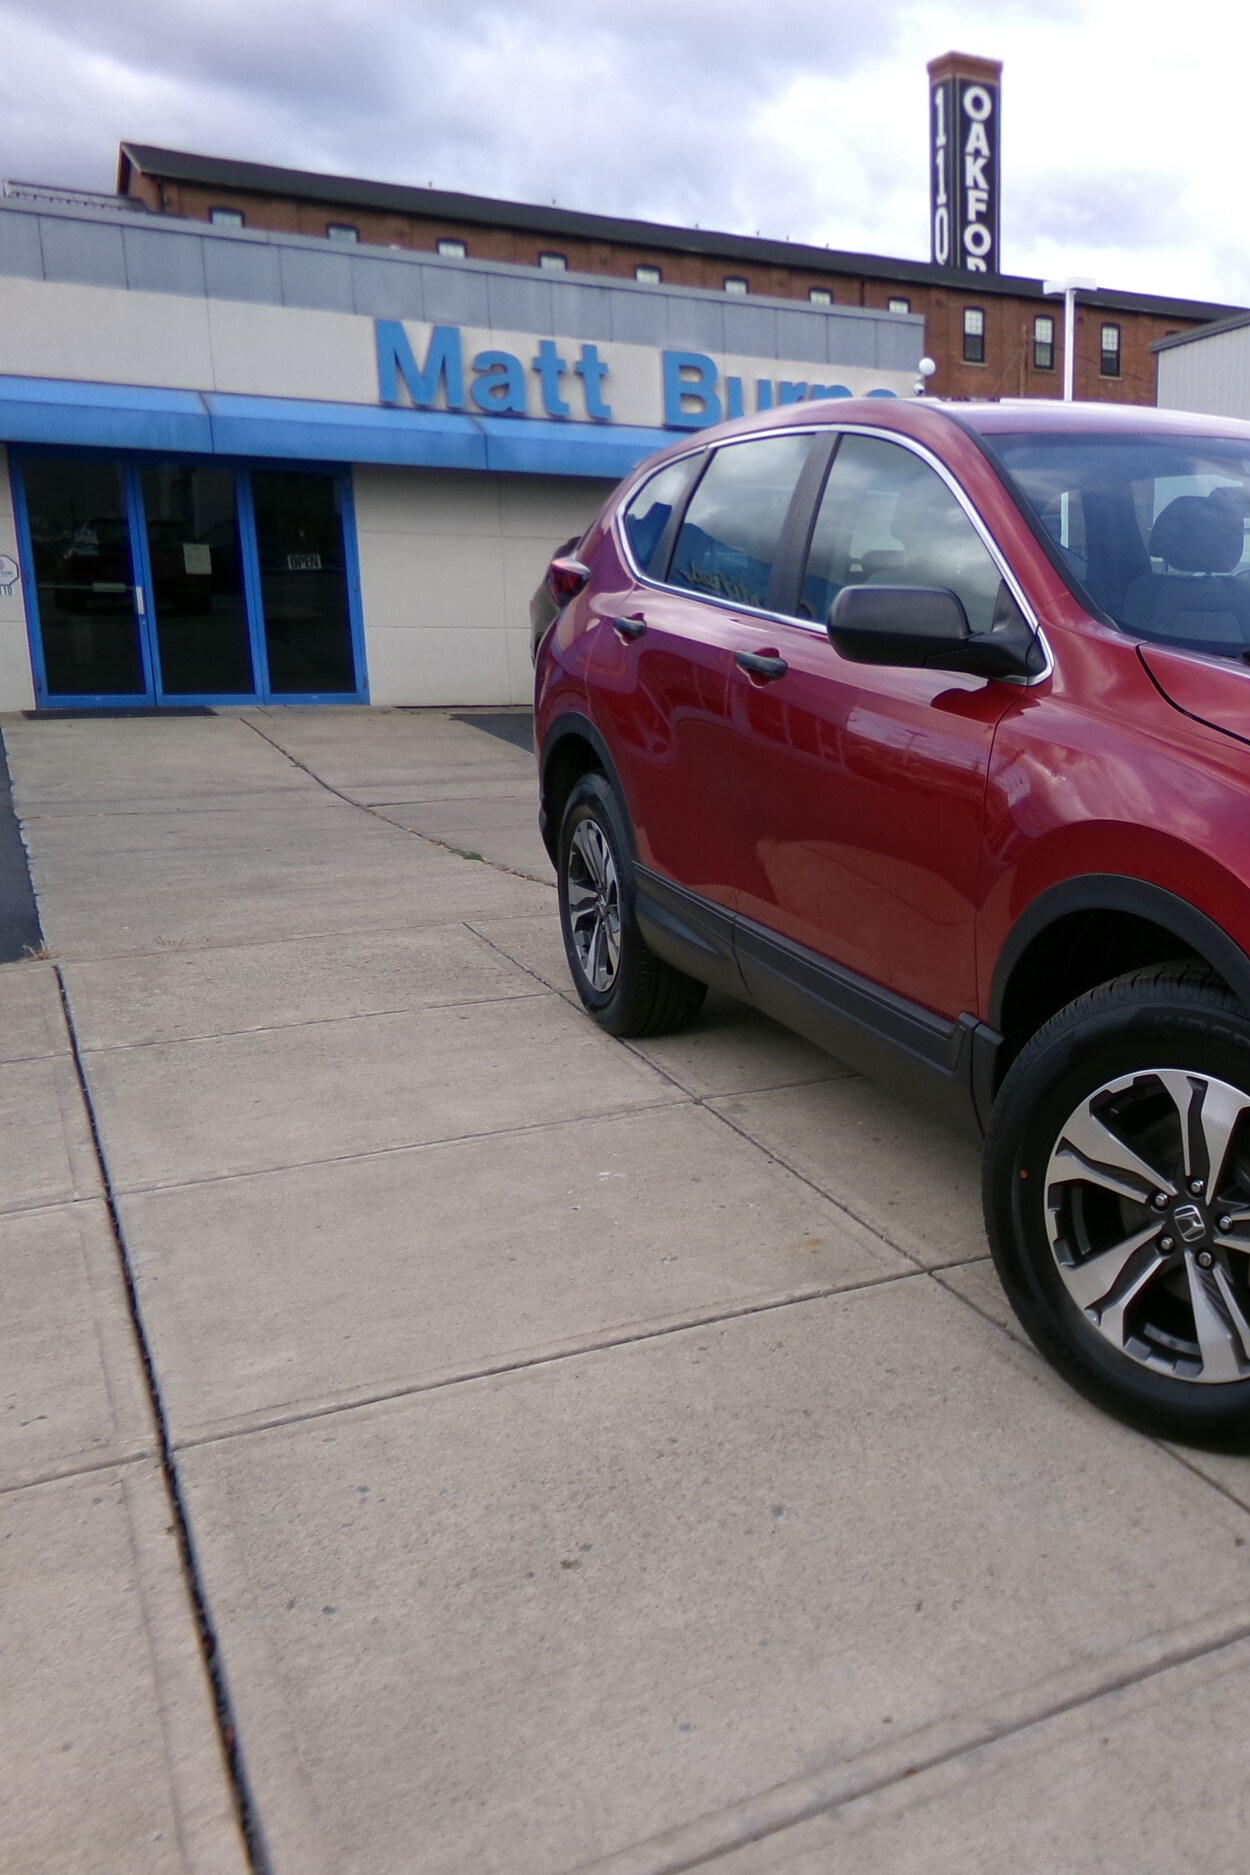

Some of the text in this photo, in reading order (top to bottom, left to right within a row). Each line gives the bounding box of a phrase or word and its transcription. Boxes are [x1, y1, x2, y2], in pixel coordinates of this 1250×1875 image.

[374, 319, 898, 427] Matt Bur
[290, 555, 319, 569] OPEN
